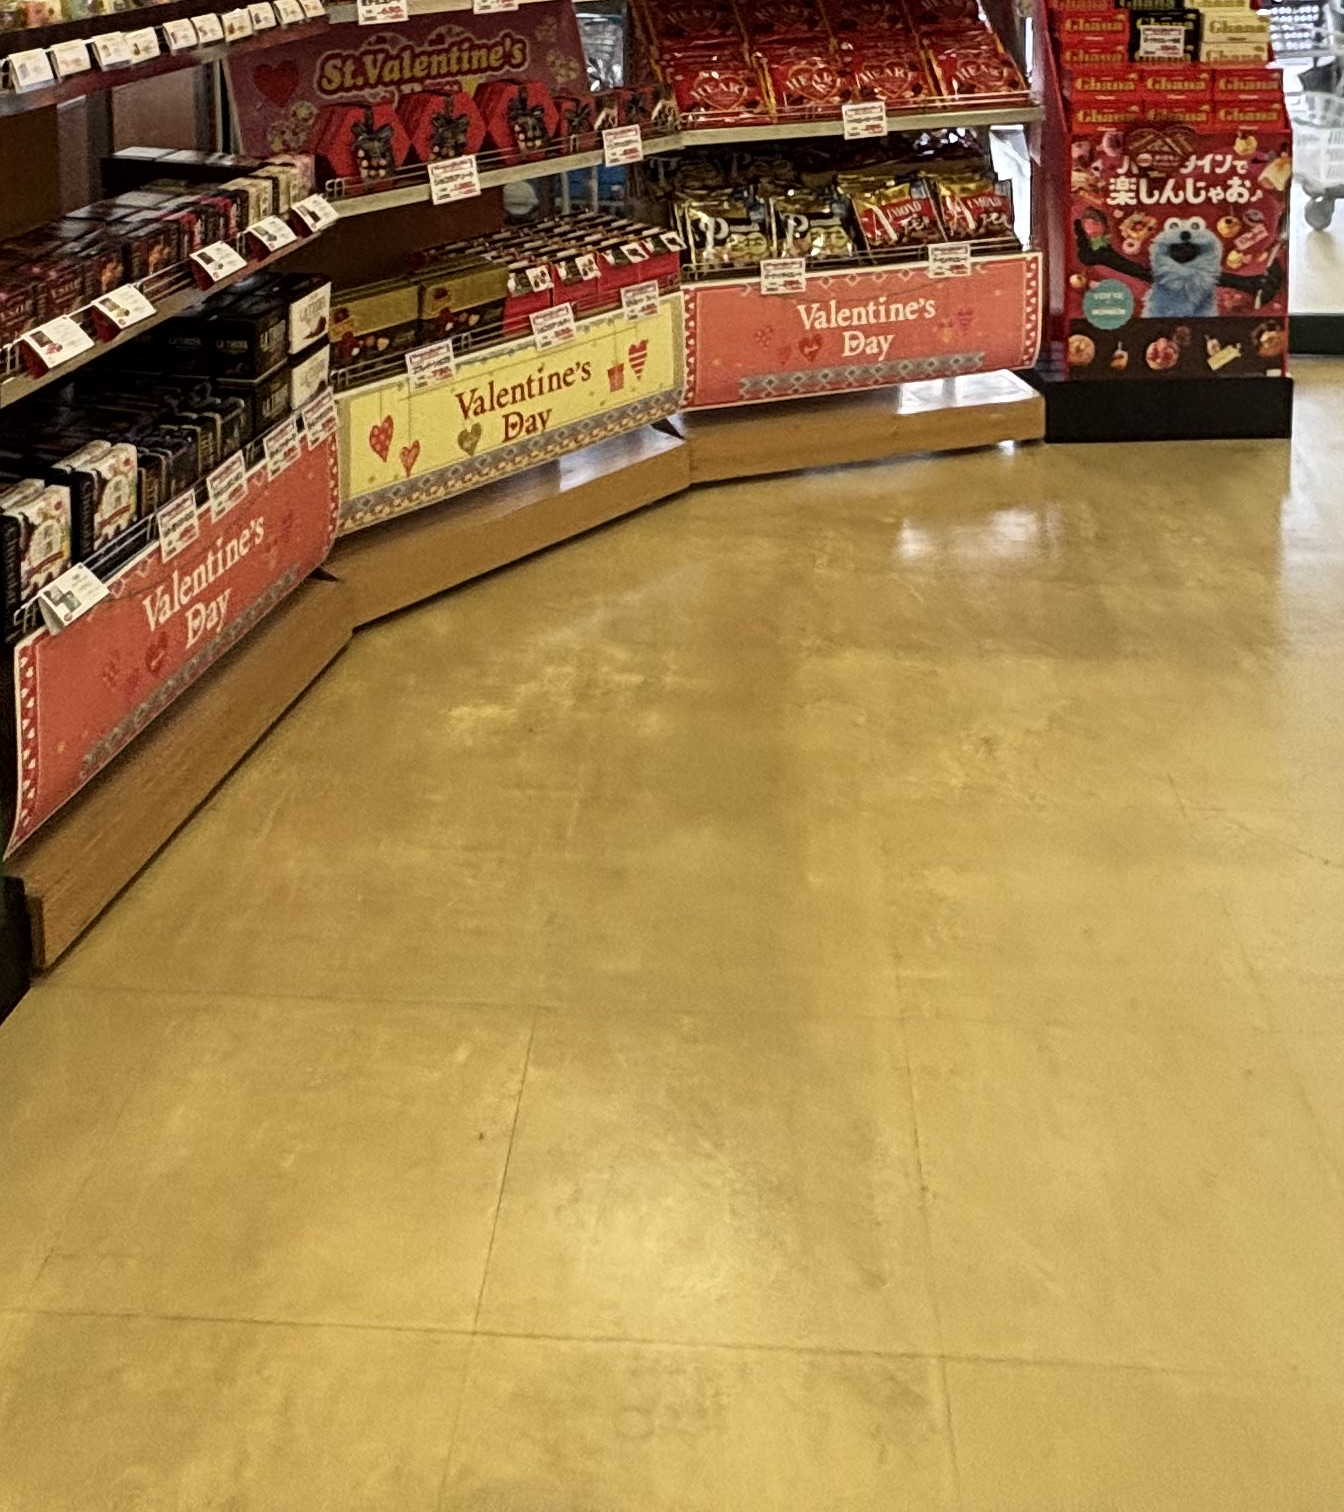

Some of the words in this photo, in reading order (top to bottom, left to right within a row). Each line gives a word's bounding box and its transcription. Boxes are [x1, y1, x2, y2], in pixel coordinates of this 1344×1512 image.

[1064, 18, 1123, 33] Ghana
[1208, 19, 1267, 34] Ghana
[1064, 49, 1123, 64] Ghana
[1074, 77, 1136, 91] Ghana
[1146, 76, 1206, 91] Ghana
[1219, 77, 1279, 91] Ghana
[1218, 108, 1279, 122] Ghana
[796, 297, 937, 331] Valentine's
[841, 331, 896, 362] Day
[456, 360, 593, 421] Valentine's
[502, 408, 553, 445] Day
[142, 515, 266, 633] Valentine's
[184, 588, 234, 650] Day
